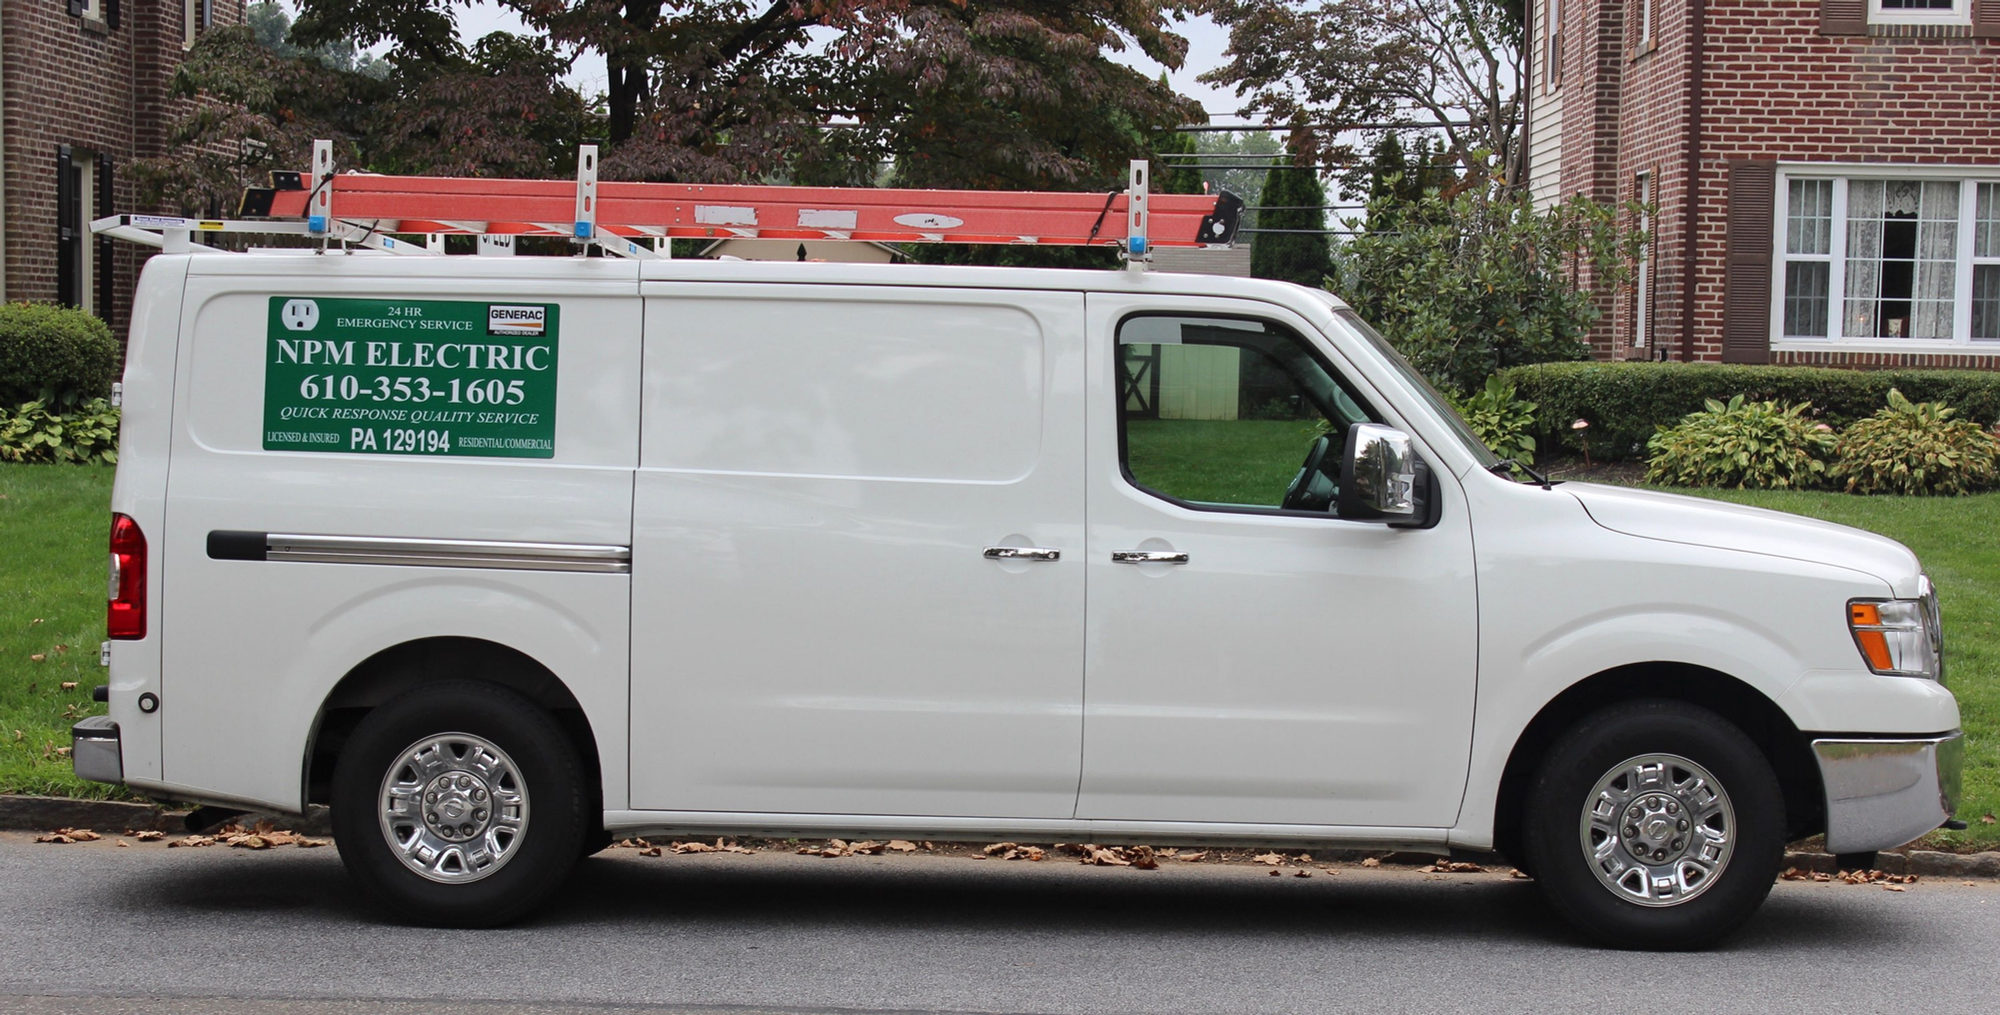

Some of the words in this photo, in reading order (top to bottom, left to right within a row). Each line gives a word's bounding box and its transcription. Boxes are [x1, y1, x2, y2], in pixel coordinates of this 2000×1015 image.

[388, 306, 402, 316] 24
[405, 307, 422, 316] HR
[491, 310, 543, 320] GENERAC
[336, 318, 416, 329] EMERGENCY
[419, 320, 473, 330] SERVICE
[275, 339, 355, 366] NPM
[365, 341, 550, 371] ELECTRIC
[300, 374, 525, 405] 610-353-1605
[280, 407, 328, 420] QUICK
[332, 408, 408, 421] RESPONSE
[410, 410, 475, 423] QUALITY
[478, 412, 539, 425] SERVICE
[267, 431, 301, 442] LICENSED
[302, 432, 308, 442] &
[309, 432, 340, 444] INSURED
[351, 427, 377, 450] PA
[383, 428, 450, 453] 129194
[458, 436, 553, 450] RESIDENTIAL/COMMERCIAL
